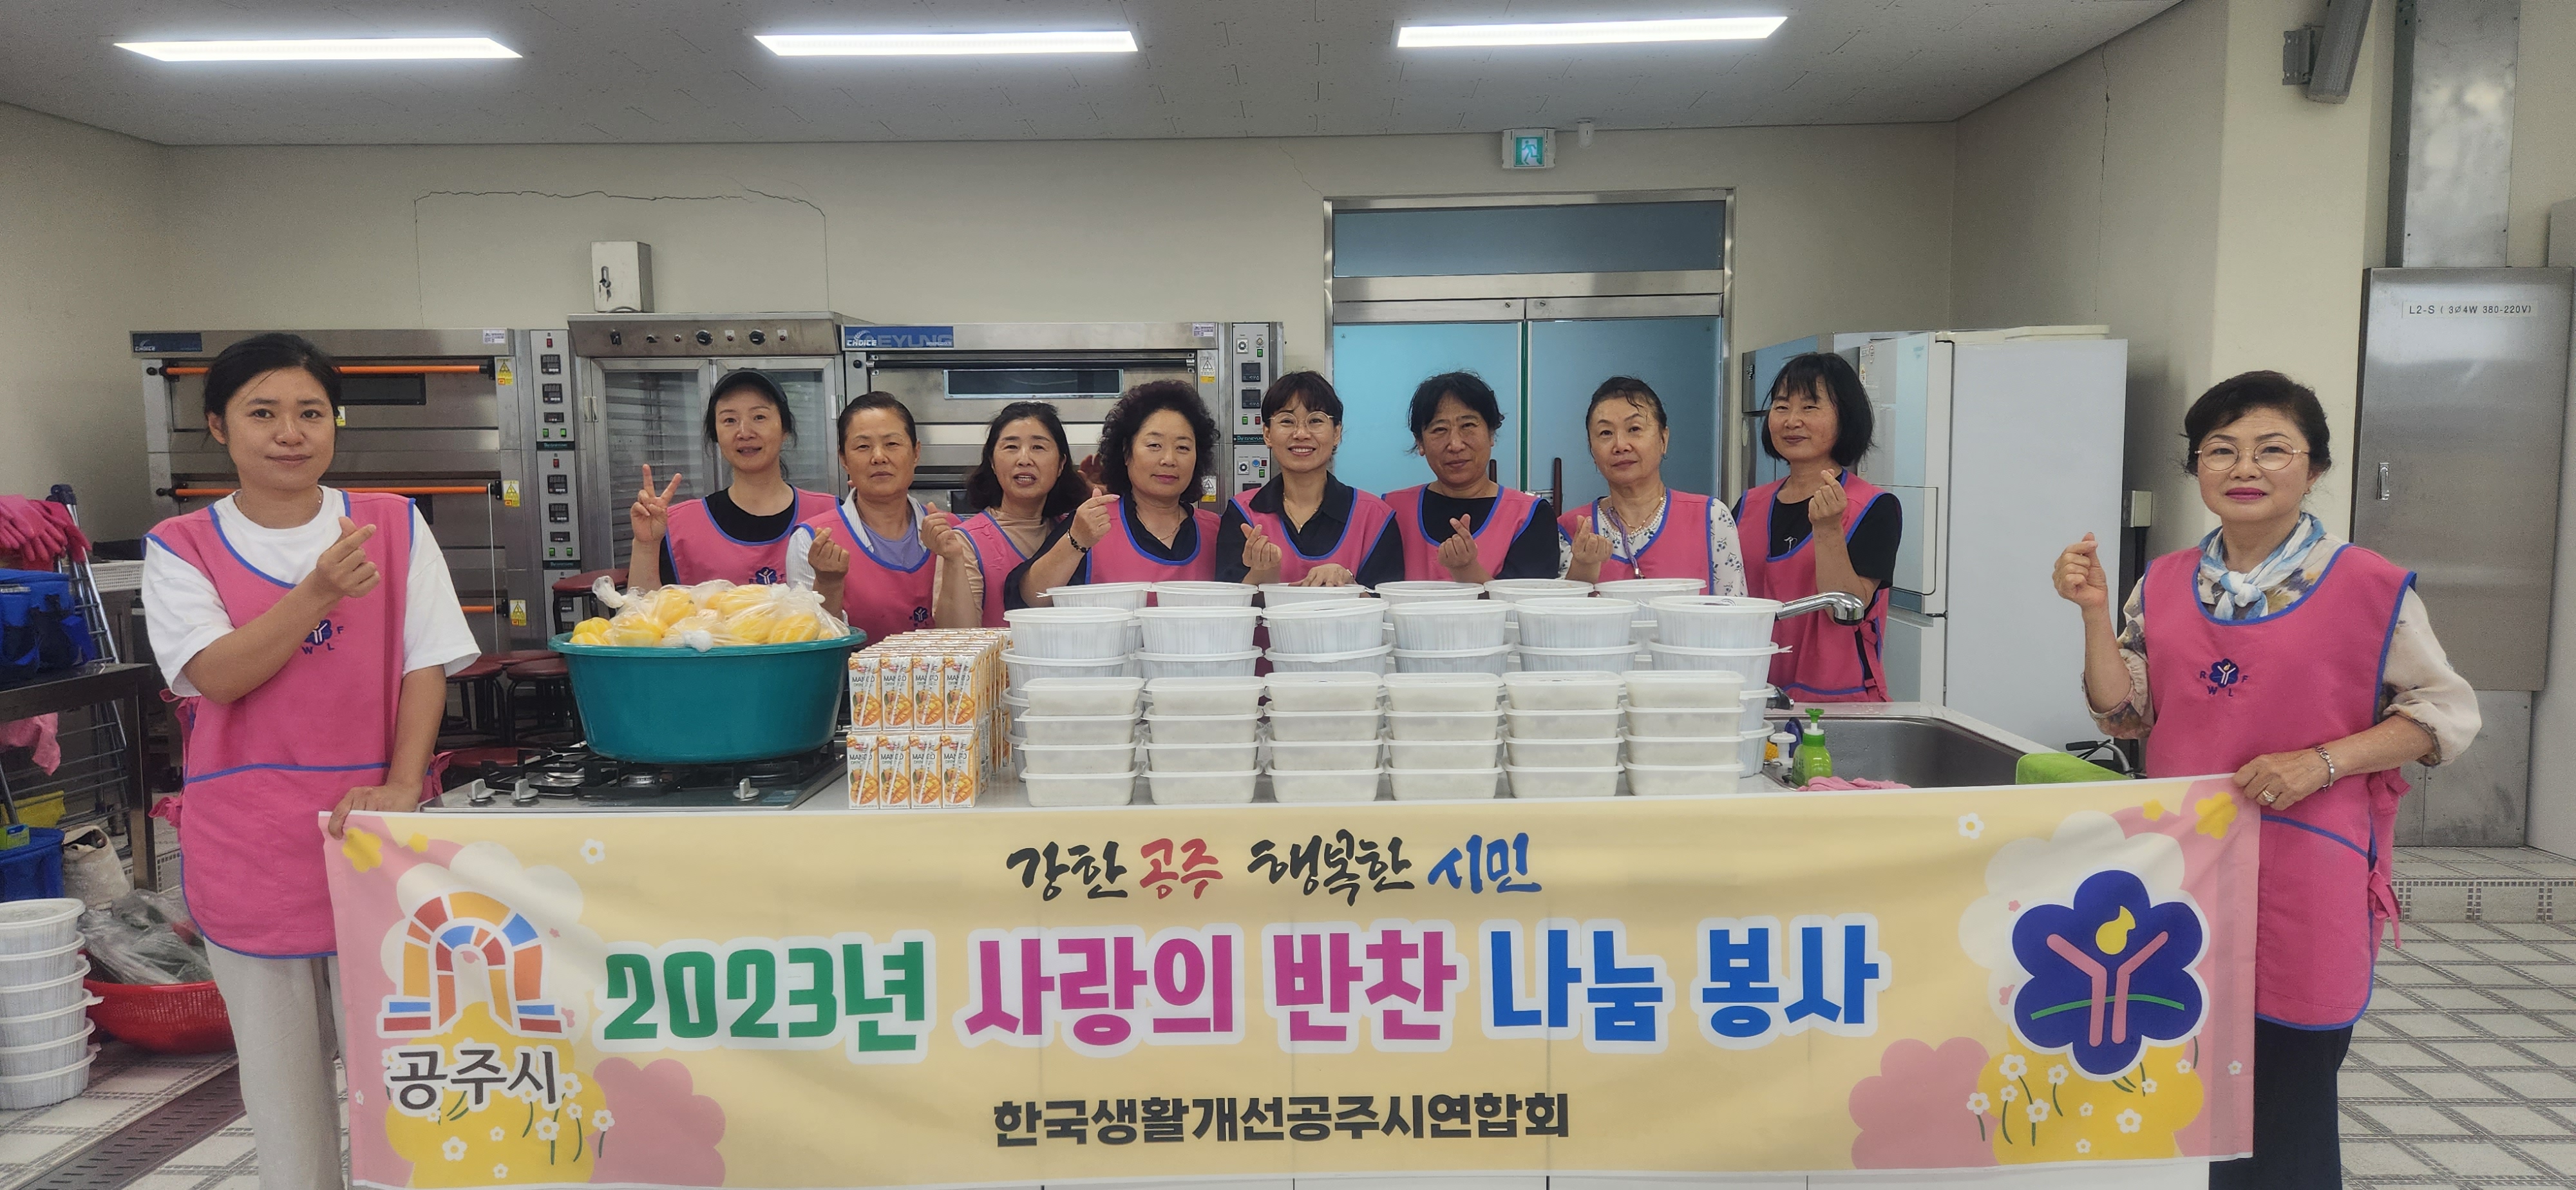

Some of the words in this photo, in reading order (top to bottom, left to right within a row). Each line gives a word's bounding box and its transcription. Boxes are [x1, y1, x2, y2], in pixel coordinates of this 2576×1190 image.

[2409, 305, 2435, 314] L2-S
[2483, 305, 2532, 314] 380-220V)
[327, 643, 335, 651] L
[337, 626, 344, 634] F
[2199, 670, 2206, 679] R
[2207, 686, 2218, 695] W
[2228, 688, 2233, 697] L
[1006, 841, 1128, 900] 강한
[1139, 838, 1223, 900] 공주
[1247, 829, 1416, 907] 행복한
[1428, 832, 1543, 894] 시민
[603, 941, 925, 1053] 2023년
[964, 934, 1235, 1046] 사랑의
[1273, 929, 1457, 1042] 반찬
[1490, 929, 1663, 1042] 나눔
[1702, 924, 1880, 1038] 봉사
[390, 1049, 556, 1110] 공주시
[993, 1093, 1569, 1149] 한국생활개선공주시연합회
